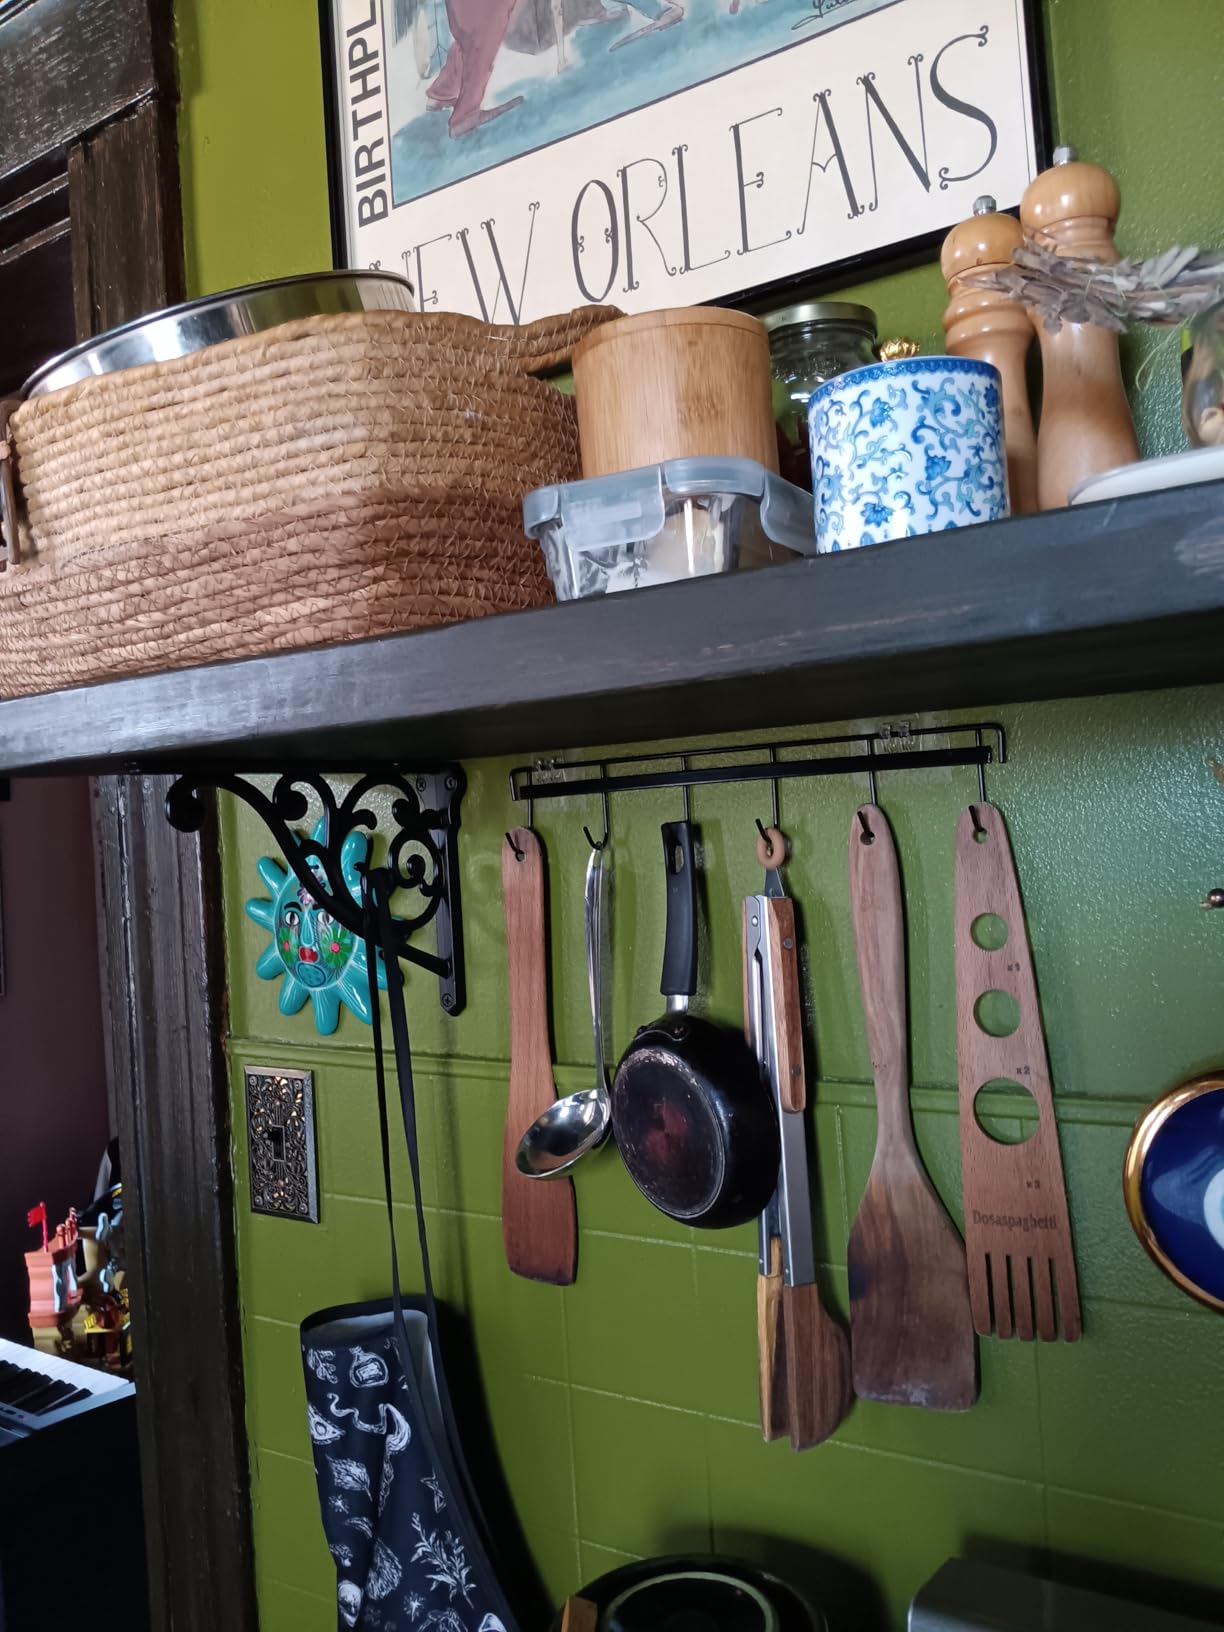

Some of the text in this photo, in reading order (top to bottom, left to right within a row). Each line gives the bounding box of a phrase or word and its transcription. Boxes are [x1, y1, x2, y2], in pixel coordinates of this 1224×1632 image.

[346, 0, 388, 228] BIRTHPL
[368, 25, 997, 325] EW ORLEANS
